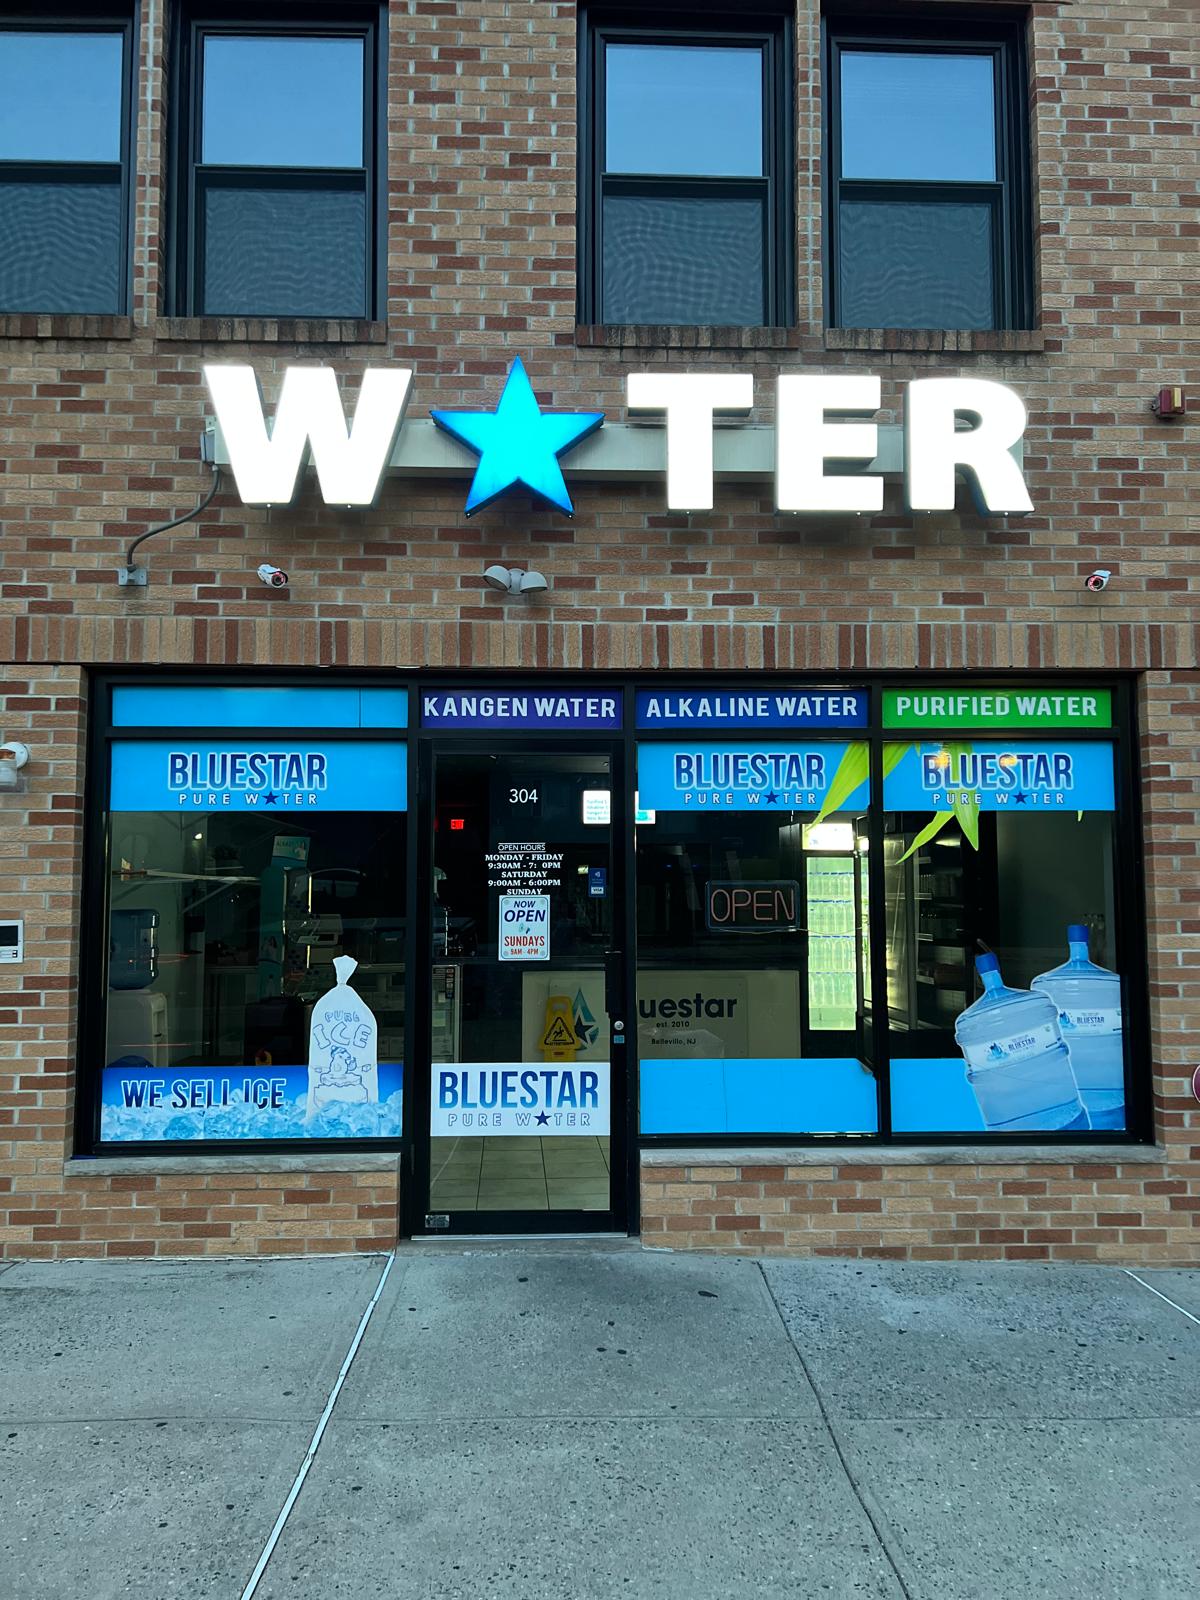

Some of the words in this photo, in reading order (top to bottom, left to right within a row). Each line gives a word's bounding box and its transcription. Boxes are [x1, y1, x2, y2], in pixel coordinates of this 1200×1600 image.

[204, 357, 1035, 516] WTER
[424, 697, 528, 718] KANGEN
[534, 696, 617, 718] WATER
[646, 696, 770, 718] ALKALINE
[775, 696, 858, 717] WATER
[896, 696, 1011, 717] PURIFIED
[1016, 696, 1098, 717] WATER
[169, 752, 327, 790] BLUESTAR
[675, 753, 825, 790] BLUESTAR
[923, 753, 1073, 790] BLUESTAR
[179, 793, 231, 805] PURE
[245, 791, 318, 805] WTER
[509, 788, 539, 804] 304
[685, 792, 734, 805] PURE
[748, 790, 817, 805] WTER
[933, 792, 982, 805] PURE
[996, 790, 1066, 805] WTER
[513, 900, 536, 908] NOW
[710, 888, 795, 922] OPEN
[504, 910, 546, 922] OPEN
[504, 936, 545, 947] SUNDAYS
[313, 1021, 373, 1050] ICE
[121, 1079, 165, 1109] WE
[243, 1077, 287, 1110] ICE
[438, 1071, 599, 1109] BLUESTAR
[448, 1112, 502, 1127] PURE
[514, 1109, 591, 1127] WTER
